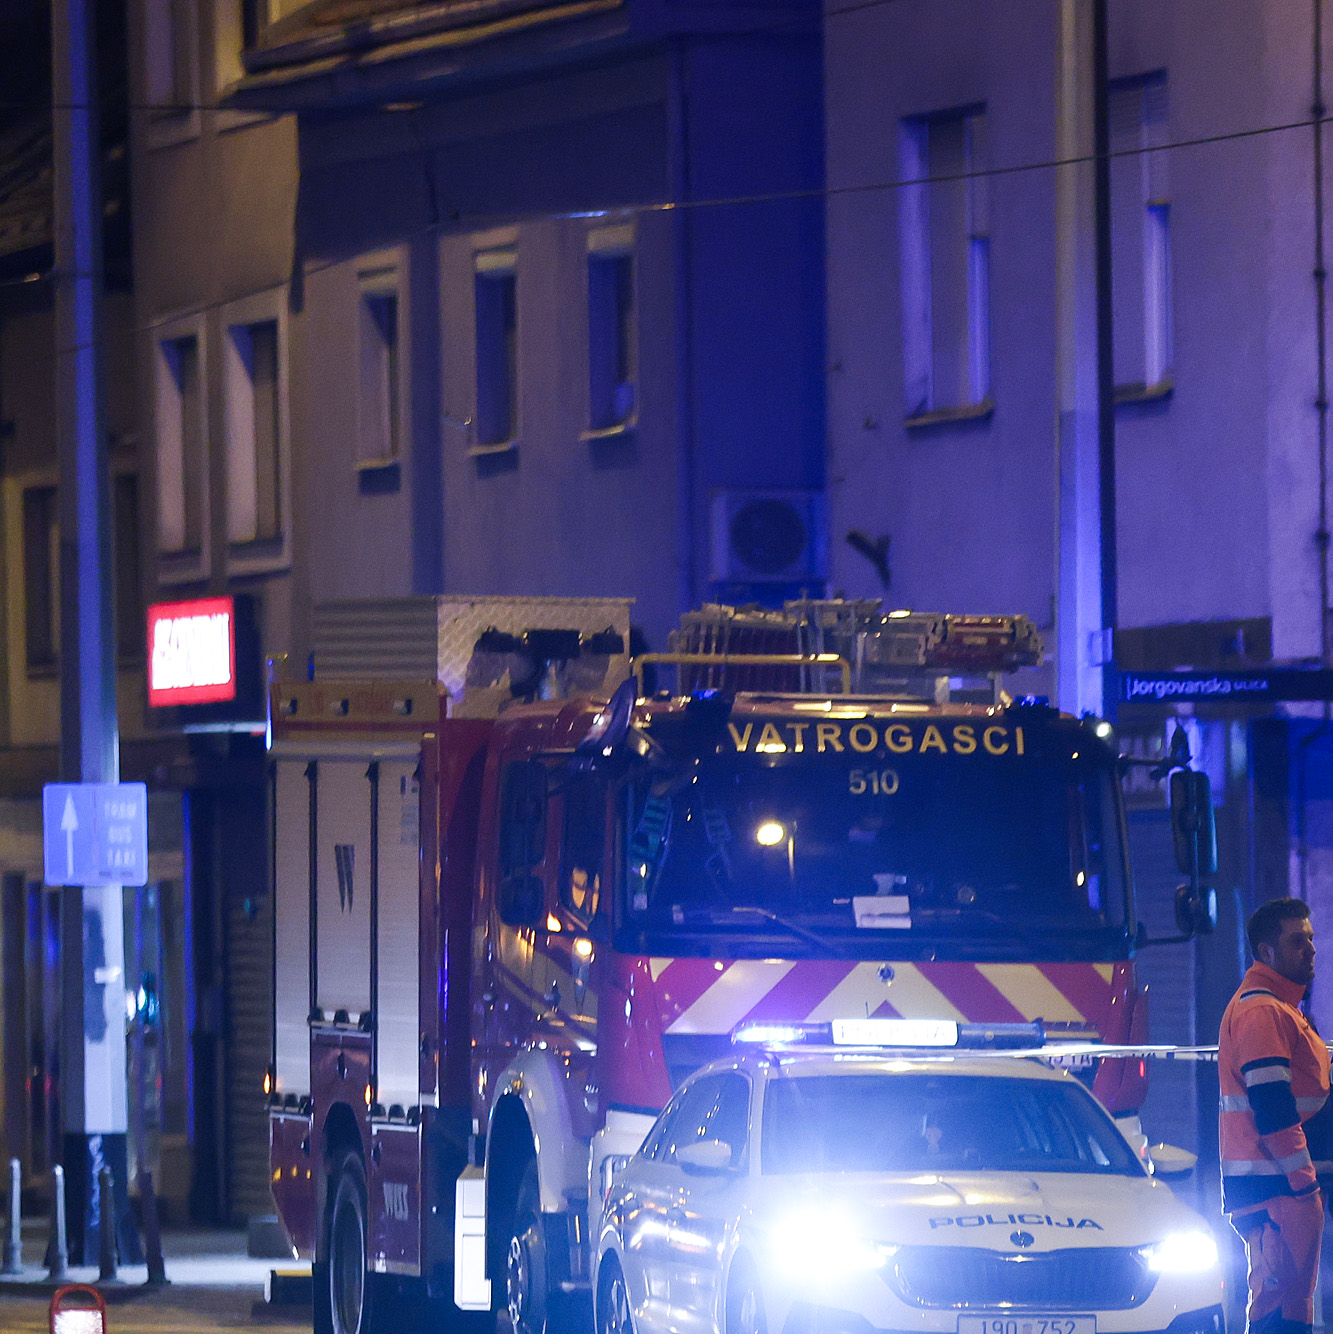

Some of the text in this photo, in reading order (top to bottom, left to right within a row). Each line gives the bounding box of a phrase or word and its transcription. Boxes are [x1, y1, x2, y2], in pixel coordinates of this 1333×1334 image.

[1131, 677, 1231, 699] Jorgovanska
[727, 722, 1026, 756] VATROGASCI
[849, 768, 899, 795] 510
[928, 1213, 1104, 1231] POLICIJA
